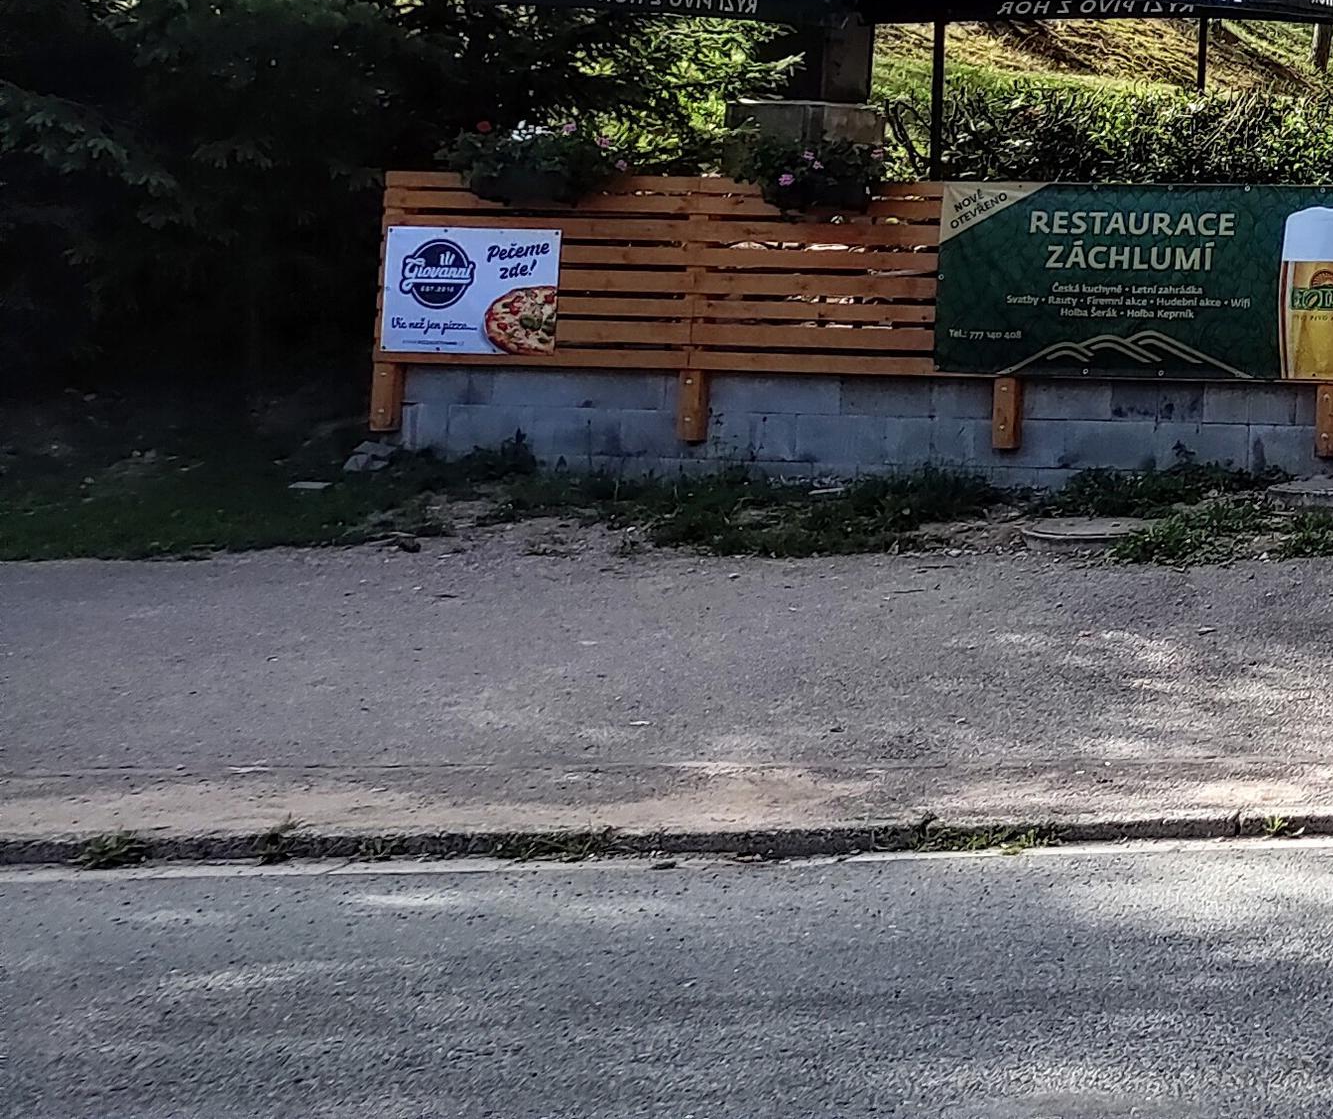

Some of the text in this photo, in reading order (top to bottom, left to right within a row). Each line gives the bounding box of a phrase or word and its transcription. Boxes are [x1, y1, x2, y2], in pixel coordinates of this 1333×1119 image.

[950, 192, 1008, 229] OTEVŘENO
[1029, 210, 1236, 236] RESTAURACE
[487, 242, 550, 263] Pečeme
[1045, 239, 1215, 271] ZÁCHLUMÍ
[499, 258, 538, 280] zde!
[1052, 281, 1080, 293] Česká
[1131, 284, 1157, 294] Letní
[1006, 294, 1039, 306] Svatby
[1048, 295, 1078, 306] Rauty
[1125, 296, 1148, 306] akce
[1156, 297, 1198, 307] Hudební
[1199, 297, 1222, 307] akce
[1060, 306, 1089, 317] Holba
[1126, 308, 1155, 318] Holba
[969, 331, 984, 340] 777
